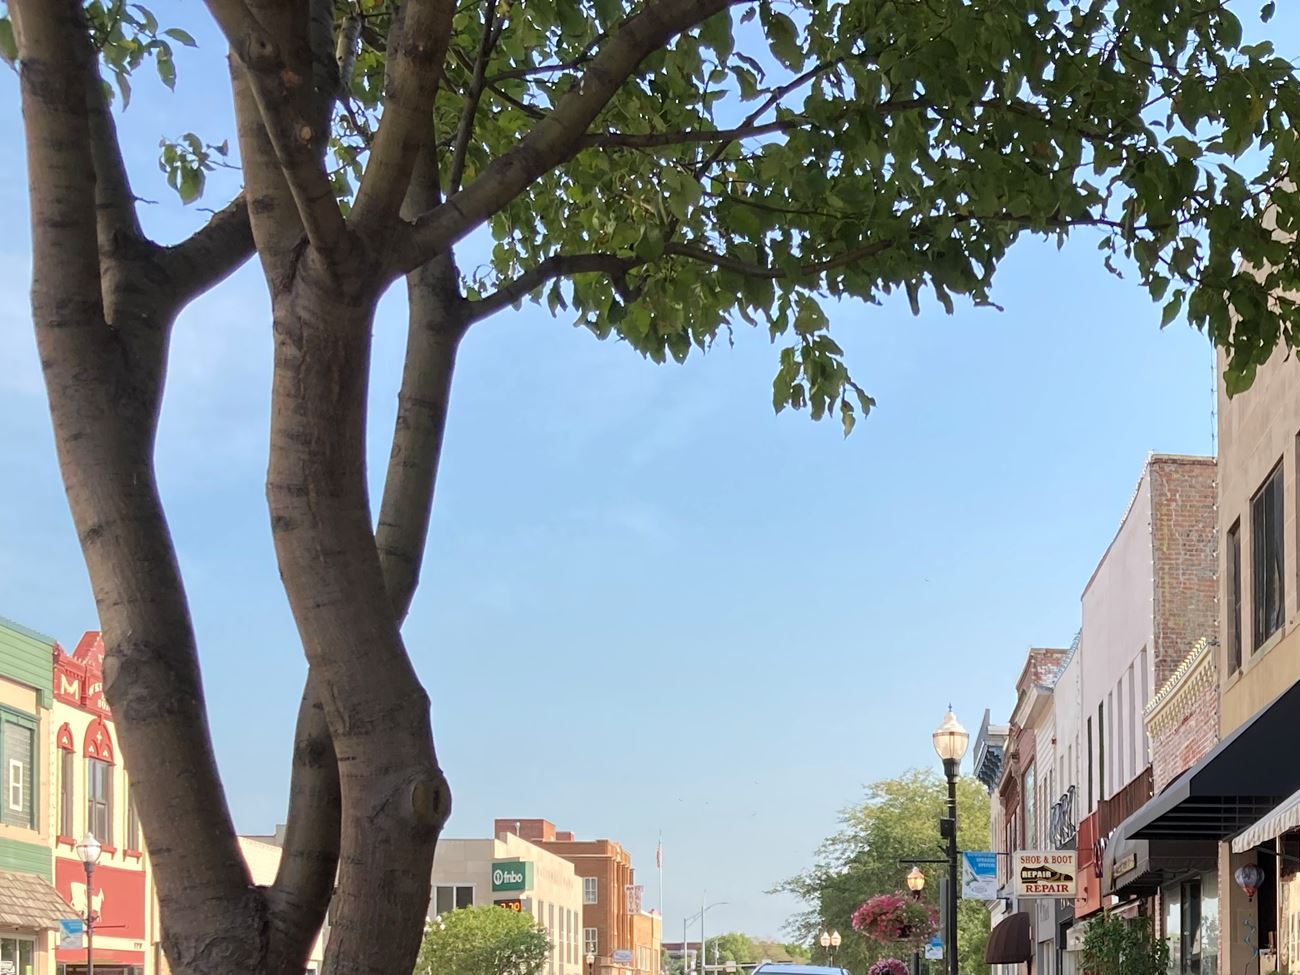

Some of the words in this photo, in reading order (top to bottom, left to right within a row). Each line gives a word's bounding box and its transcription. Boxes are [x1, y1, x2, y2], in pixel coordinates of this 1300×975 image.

[1020, 855, 1042, 864] SHOE
[1043, 855, 1049, 864] &
[1051, 855, 1073, 864] BOOT
[503, 870, 523, 884] fnbo
[1021, 870, 1052, 878] REPAIR
[1025, 884, 1069, 893] REPAIR
